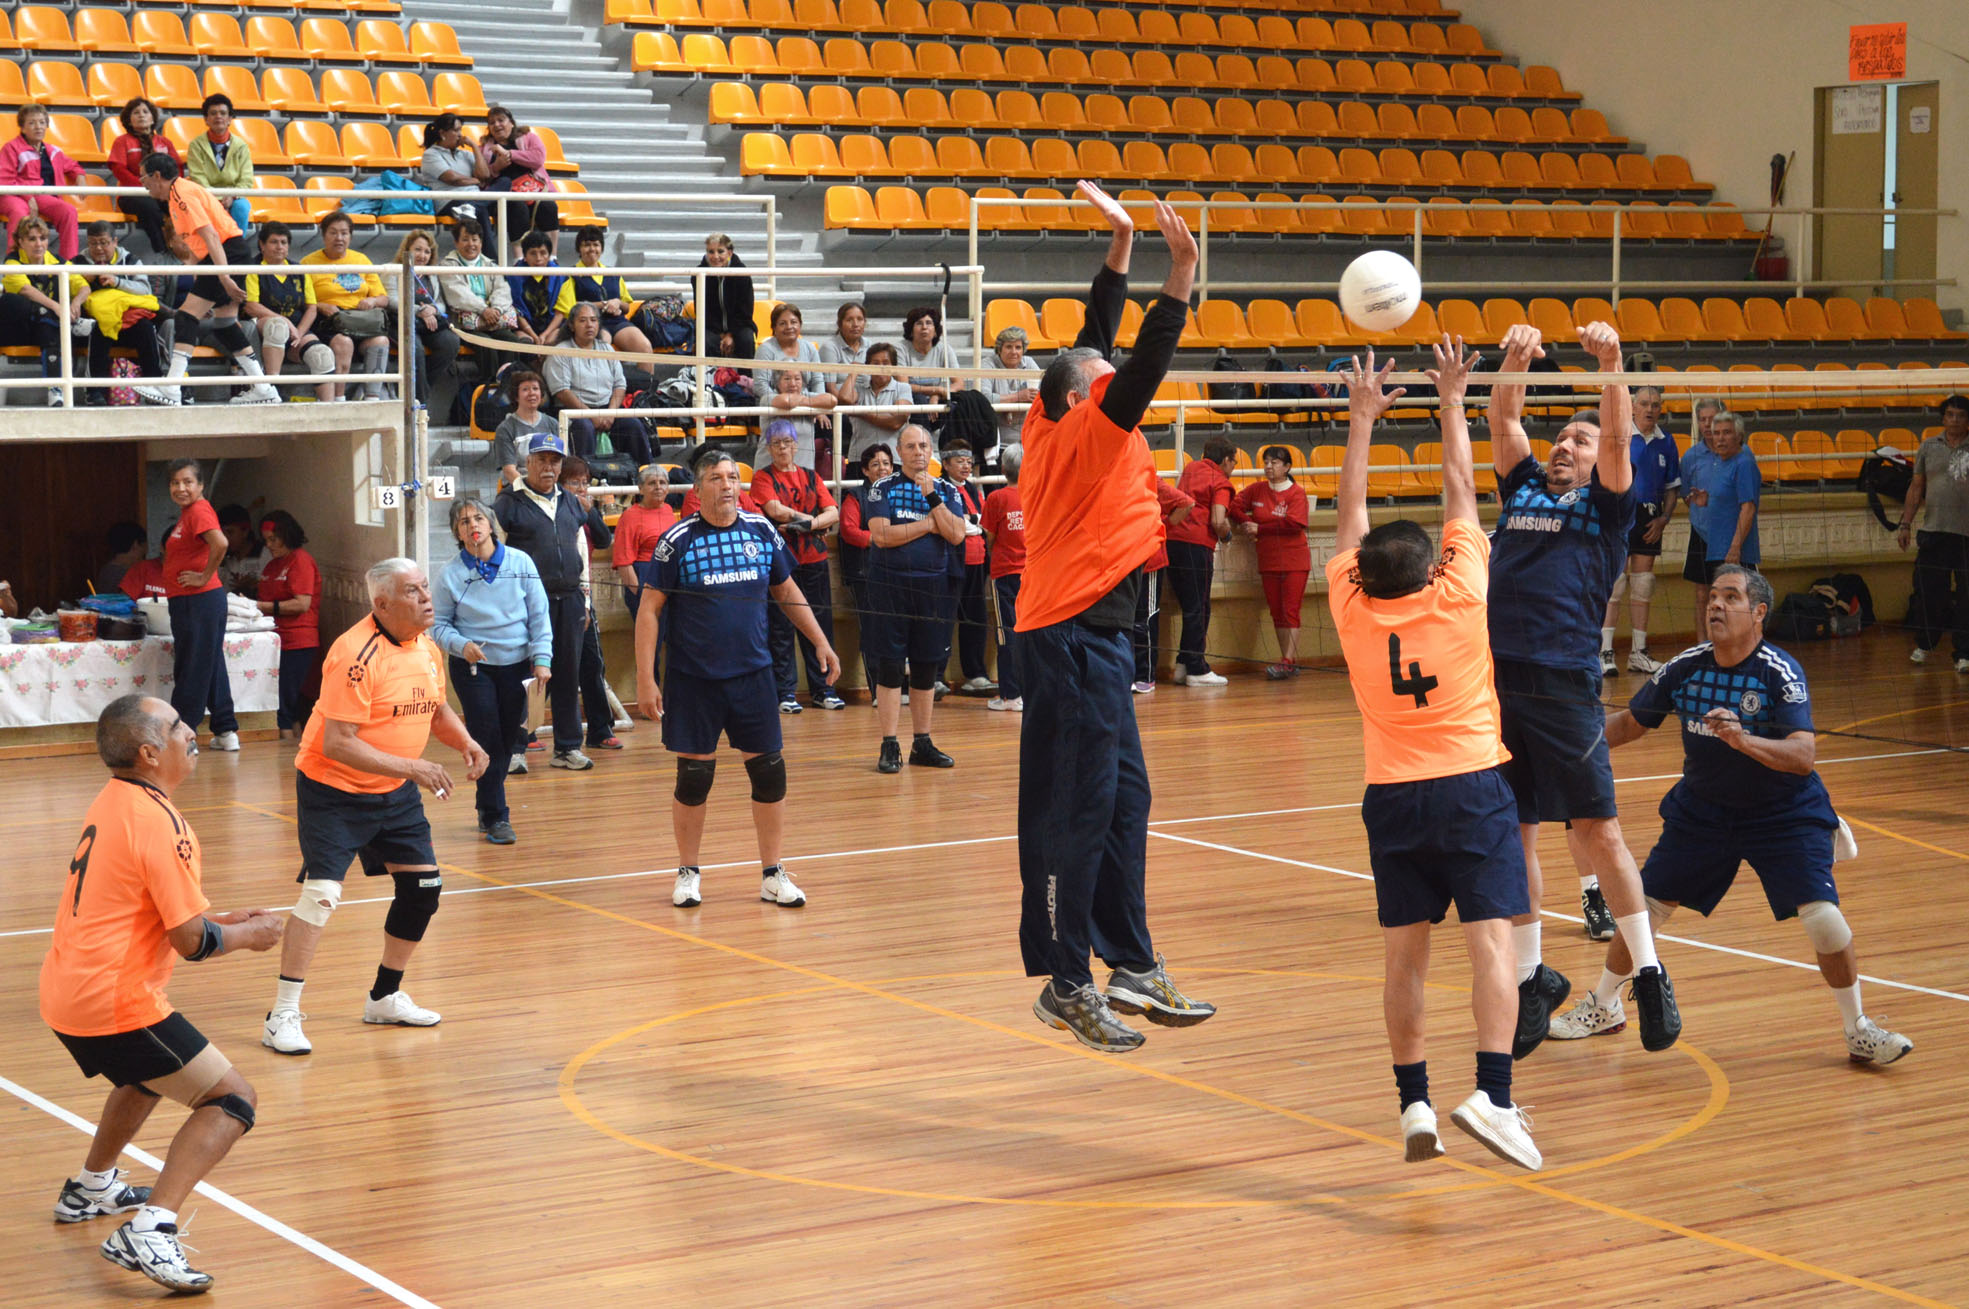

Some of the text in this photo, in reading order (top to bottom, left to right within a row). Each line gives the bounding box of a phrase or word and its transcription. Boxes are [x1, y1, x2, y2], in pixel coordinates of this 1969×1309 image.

[438, 482, 451, 495] 4
[790, 487, 801, 503] 2
[383, 492, 394, 505] 8
[896, 510, 929, 521] SAMSU
[703, 570, 758, 585] SAMSUNG
[1388, 632, 1438, 708] 4
[412, 687, 425, 699] Fly
[70, 824, 97, 917] 9
